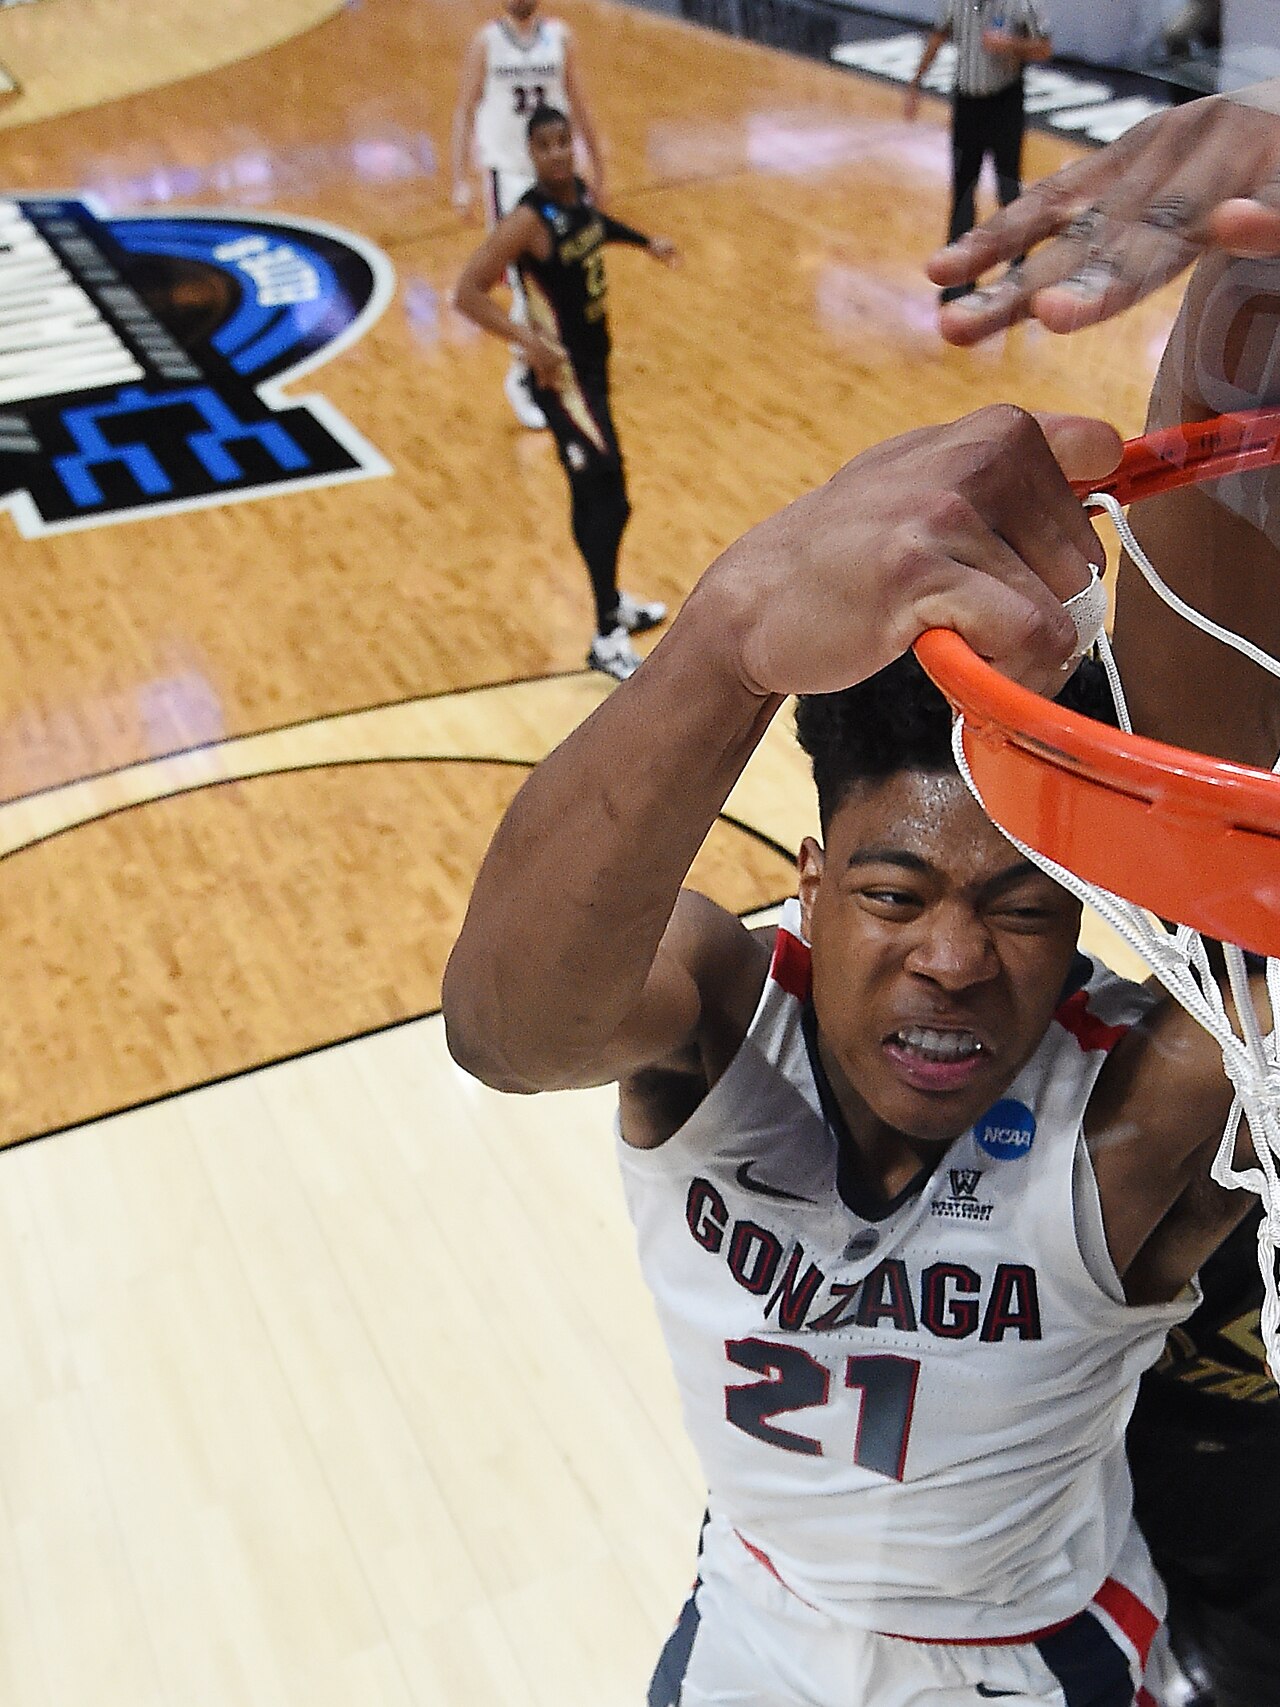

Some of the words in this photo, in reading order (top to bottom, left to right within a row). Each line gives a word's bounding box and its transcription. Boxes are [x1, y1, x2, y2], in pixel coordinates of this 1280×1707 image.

[984, 1126, 1031, 1148] NCAA
[931, 1201, 960, 1212] WEST
[961, 1202, 994, 1215] COAST
[931, 1210, 991, 1222] CONFERENCE
[685, 1176, 1042, 1343] GONZAGA
[723, 1337, 922, 1483] 21
